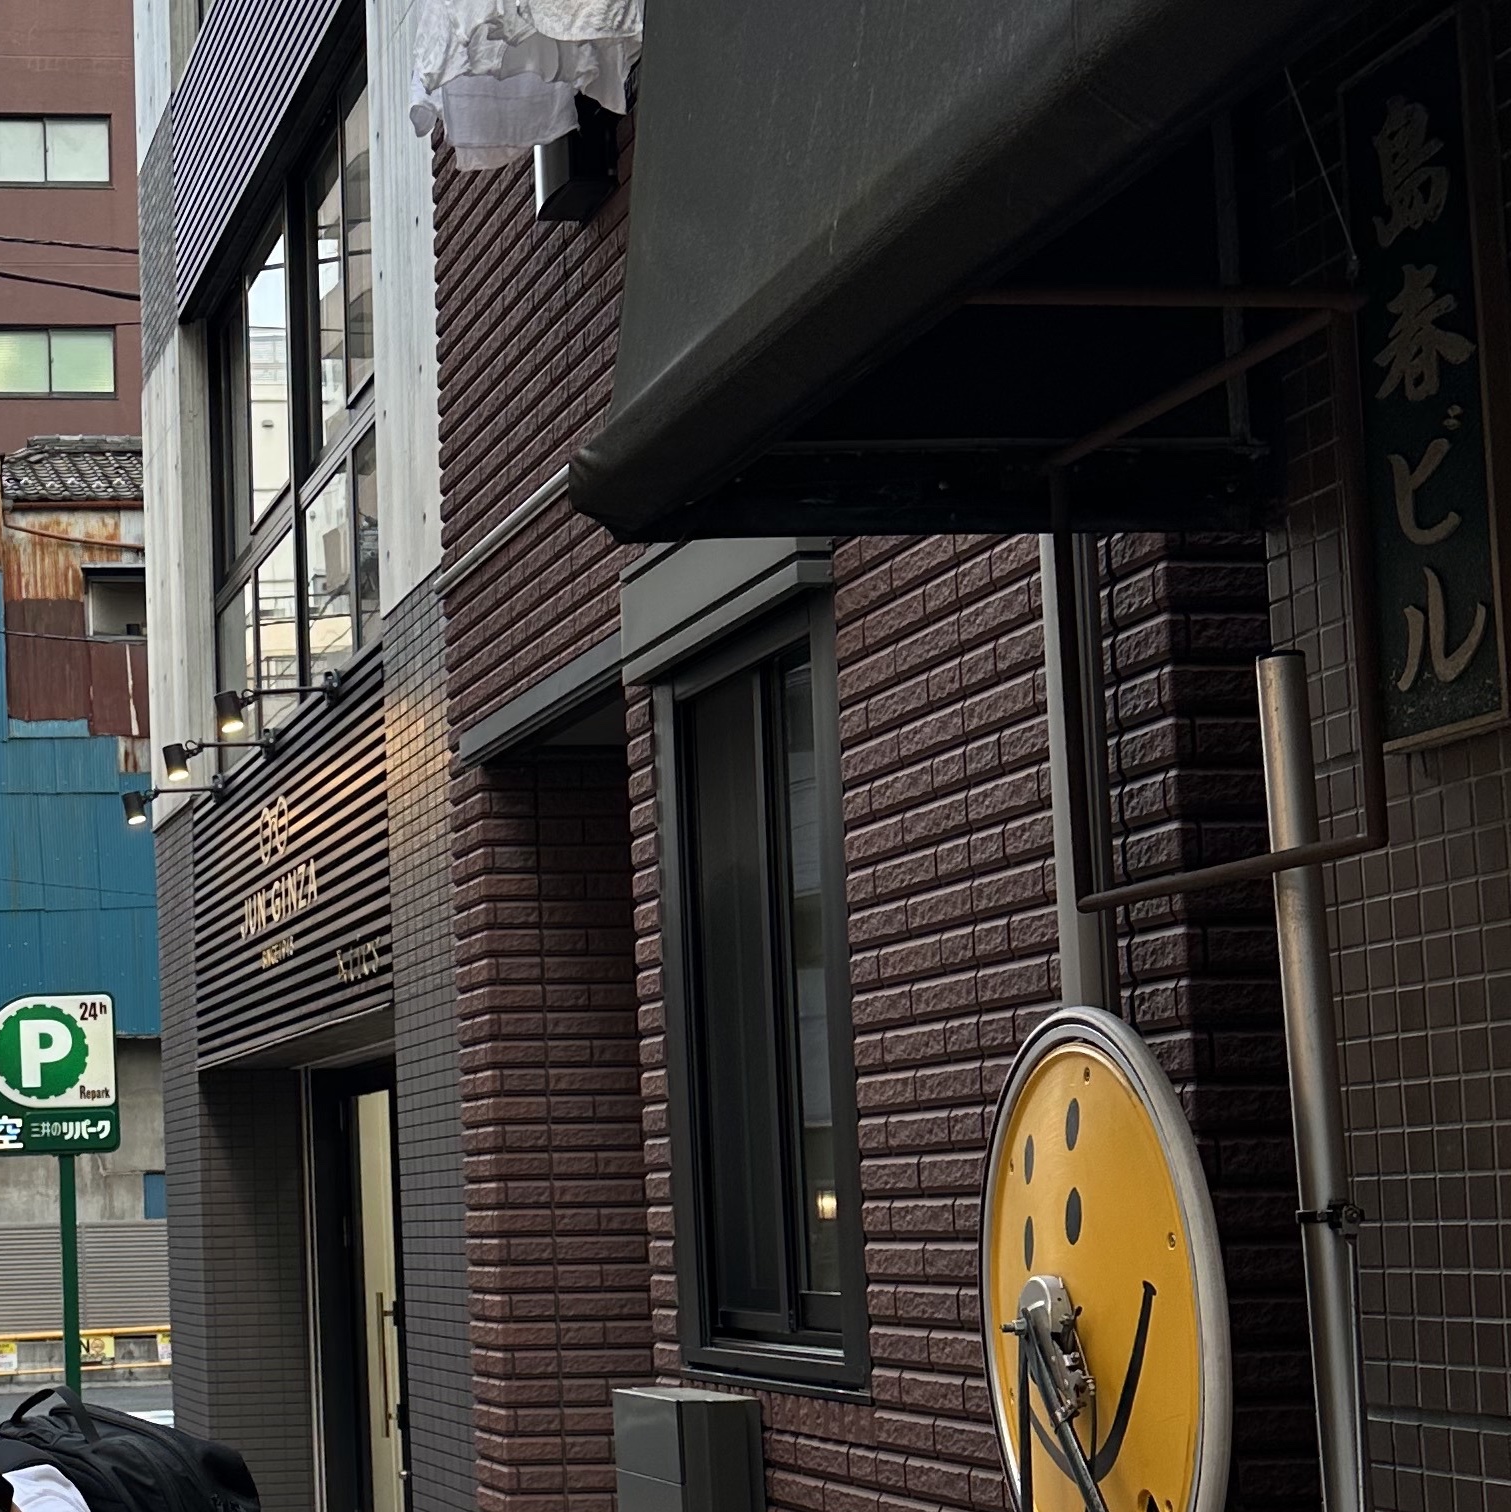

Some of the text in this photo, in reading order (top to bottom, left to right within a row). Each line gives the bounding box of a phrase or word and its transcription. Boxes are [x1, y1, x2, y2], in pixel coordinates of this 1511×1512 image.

[241, 858, 318, 941] JUN GINZA
[79, 1002, 108, 1021] 24h
[19, 1019, 73, 1088] P
[79, 1085, 111, 1101] Repark
[30, 1119, 111, 1141] 三井のリパーク
